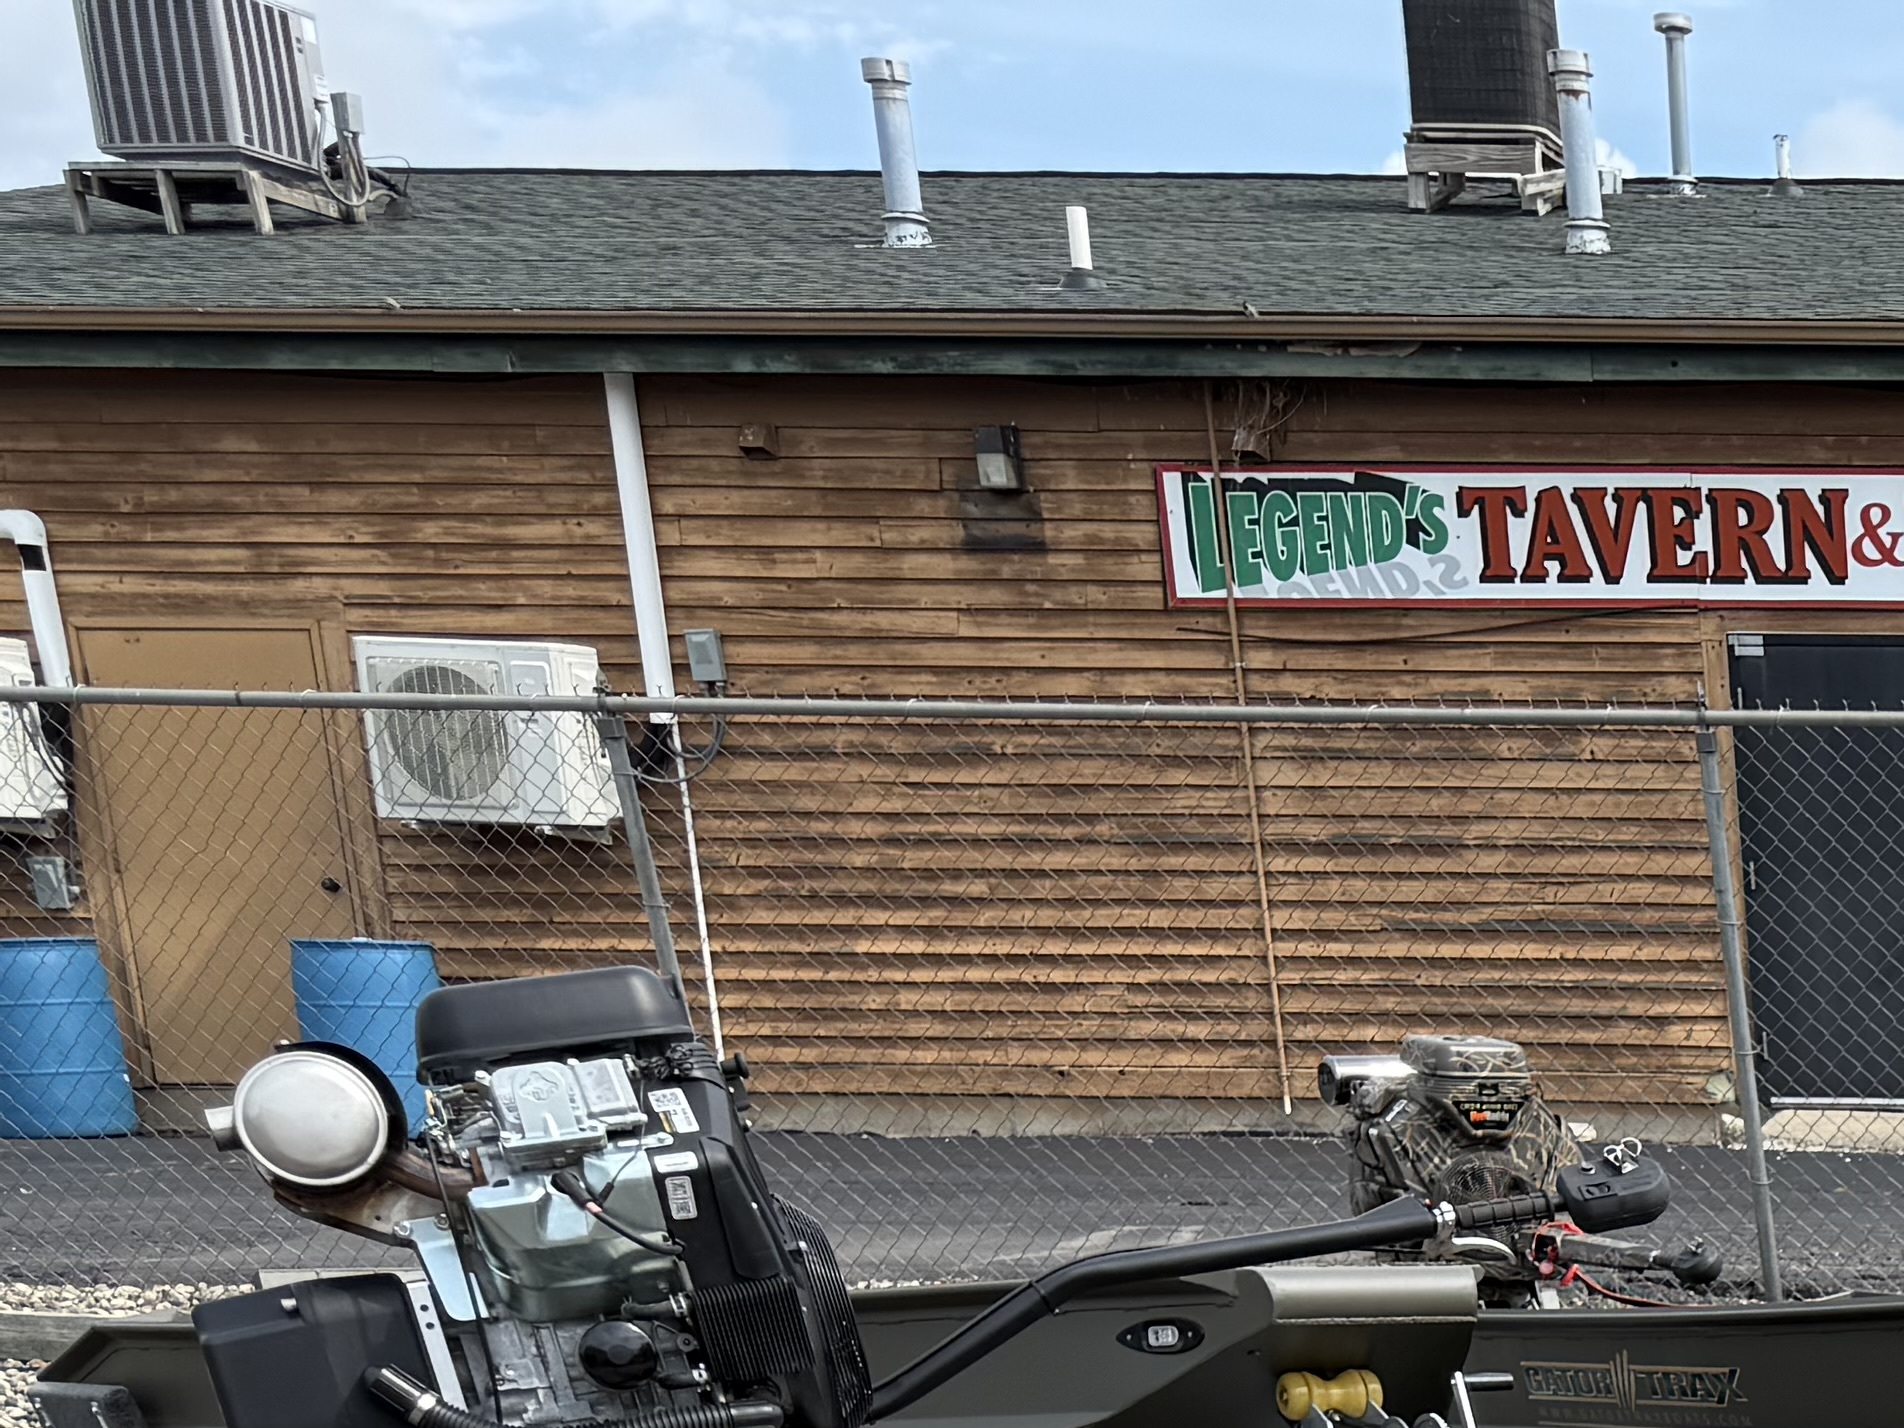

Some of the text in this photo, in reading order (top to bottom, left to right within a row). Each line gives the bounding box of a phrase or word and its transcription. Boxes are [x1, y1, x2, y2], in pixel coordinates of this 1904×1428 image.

[1188, 481, 1450, 594] LEGEND'S
[1524, 1366, 1748, 1405] GATOR TRAX
